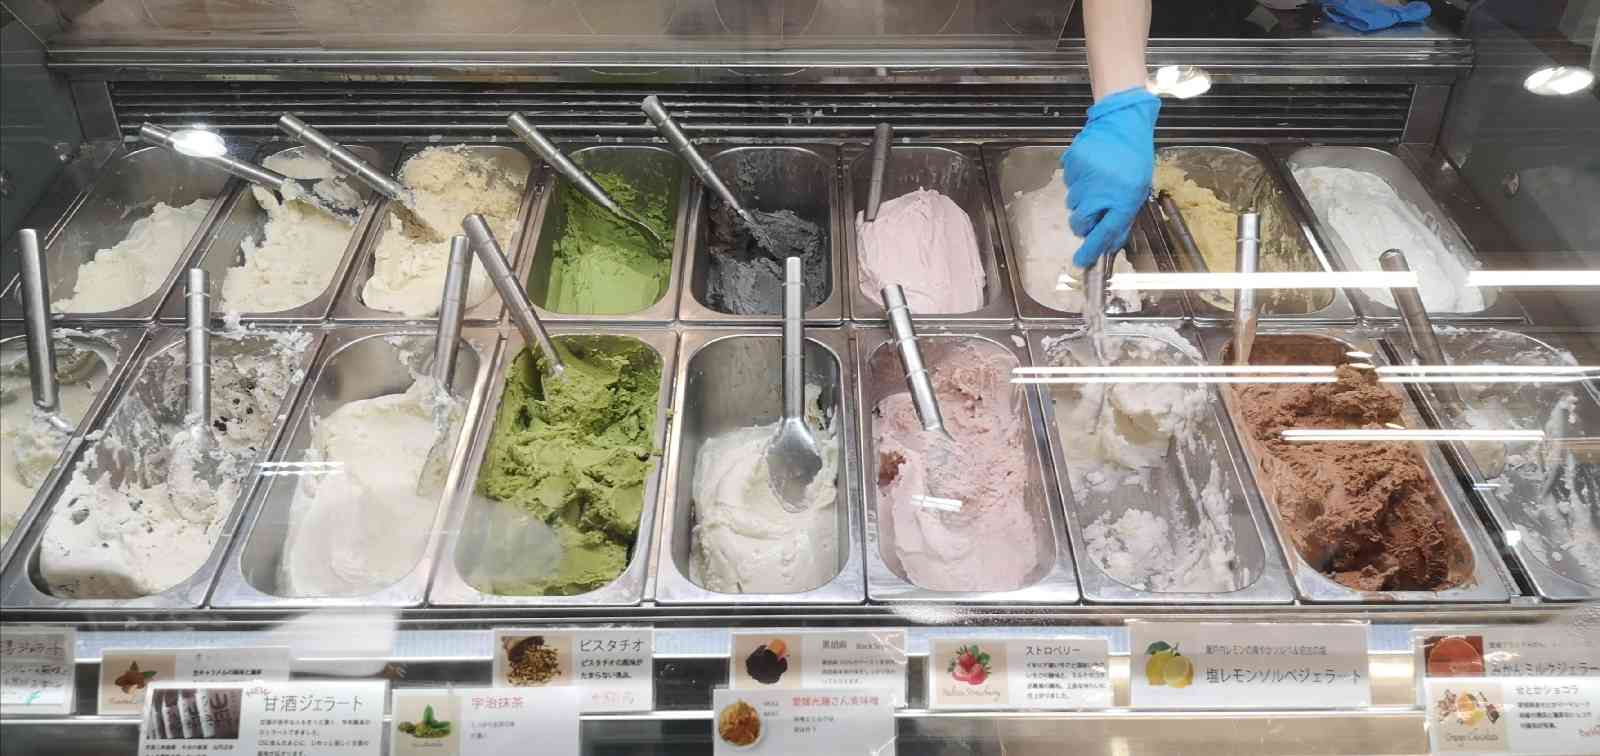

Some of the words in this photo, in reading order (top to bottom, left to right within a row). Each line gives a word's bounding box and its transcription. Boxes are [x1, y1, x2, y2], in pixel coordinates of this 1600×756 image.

[581, 639, 645, 652] ピスタチオ
[1026, 646, 1080, 656] ストロベリー
[1206, 668, 1361, 685] 塩レモンソルベジェラート
[264, 695, 363, 712] 甘酒ジェラート
